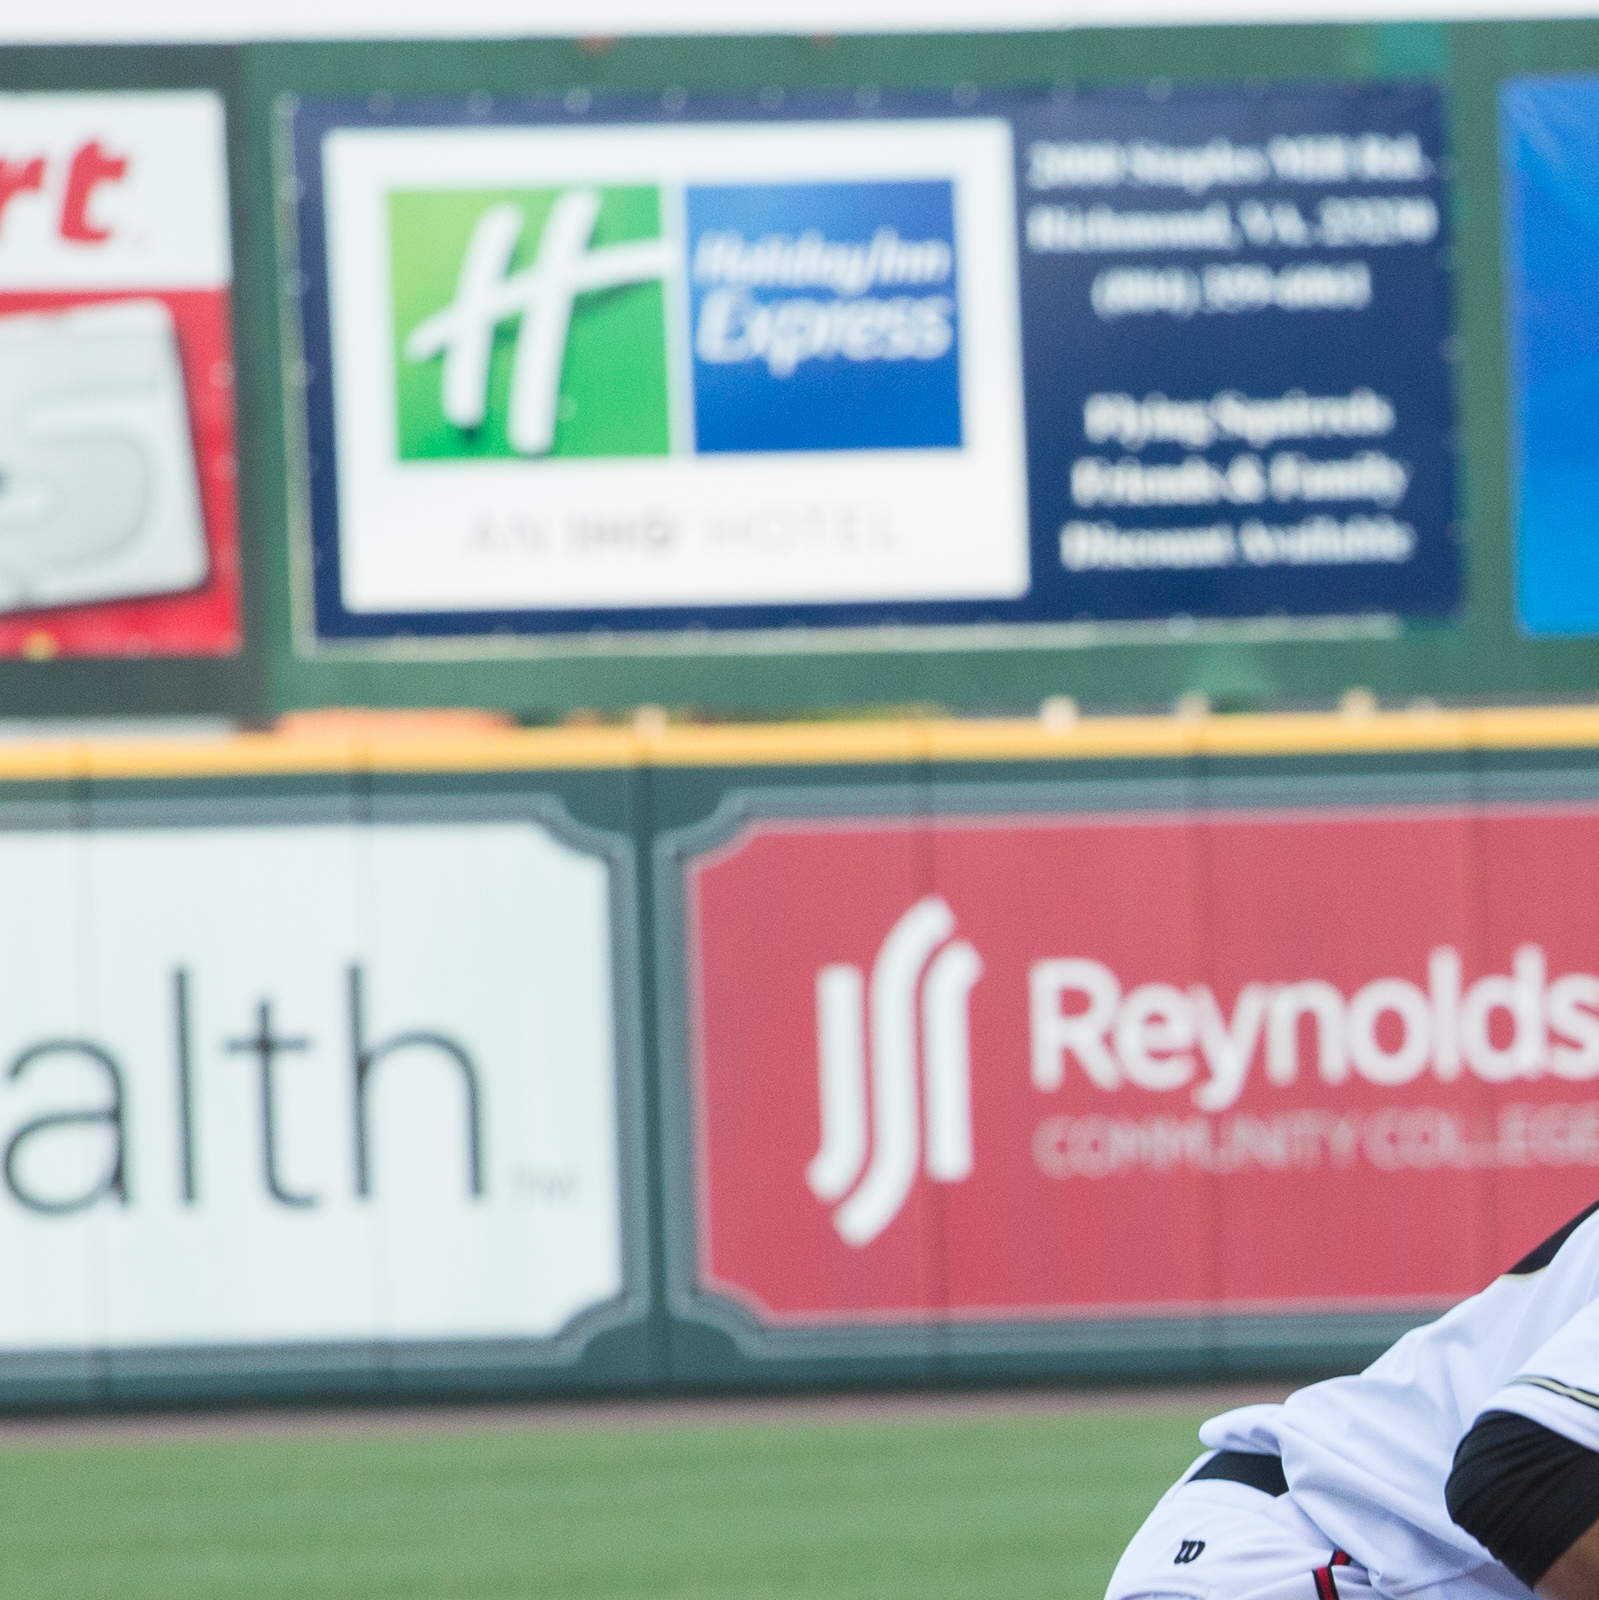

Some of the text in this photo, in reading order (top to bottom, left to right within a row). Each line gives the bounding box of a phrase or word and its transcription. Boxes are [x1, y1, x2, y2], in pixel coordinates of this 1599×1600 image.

[695, 226, 951, 295] Holiday Inn
[697, 290, 952, 377] Express
[0, 963, 487, 1214] alth
[1034, 1110, 1358, 1176] COMMUNITY
